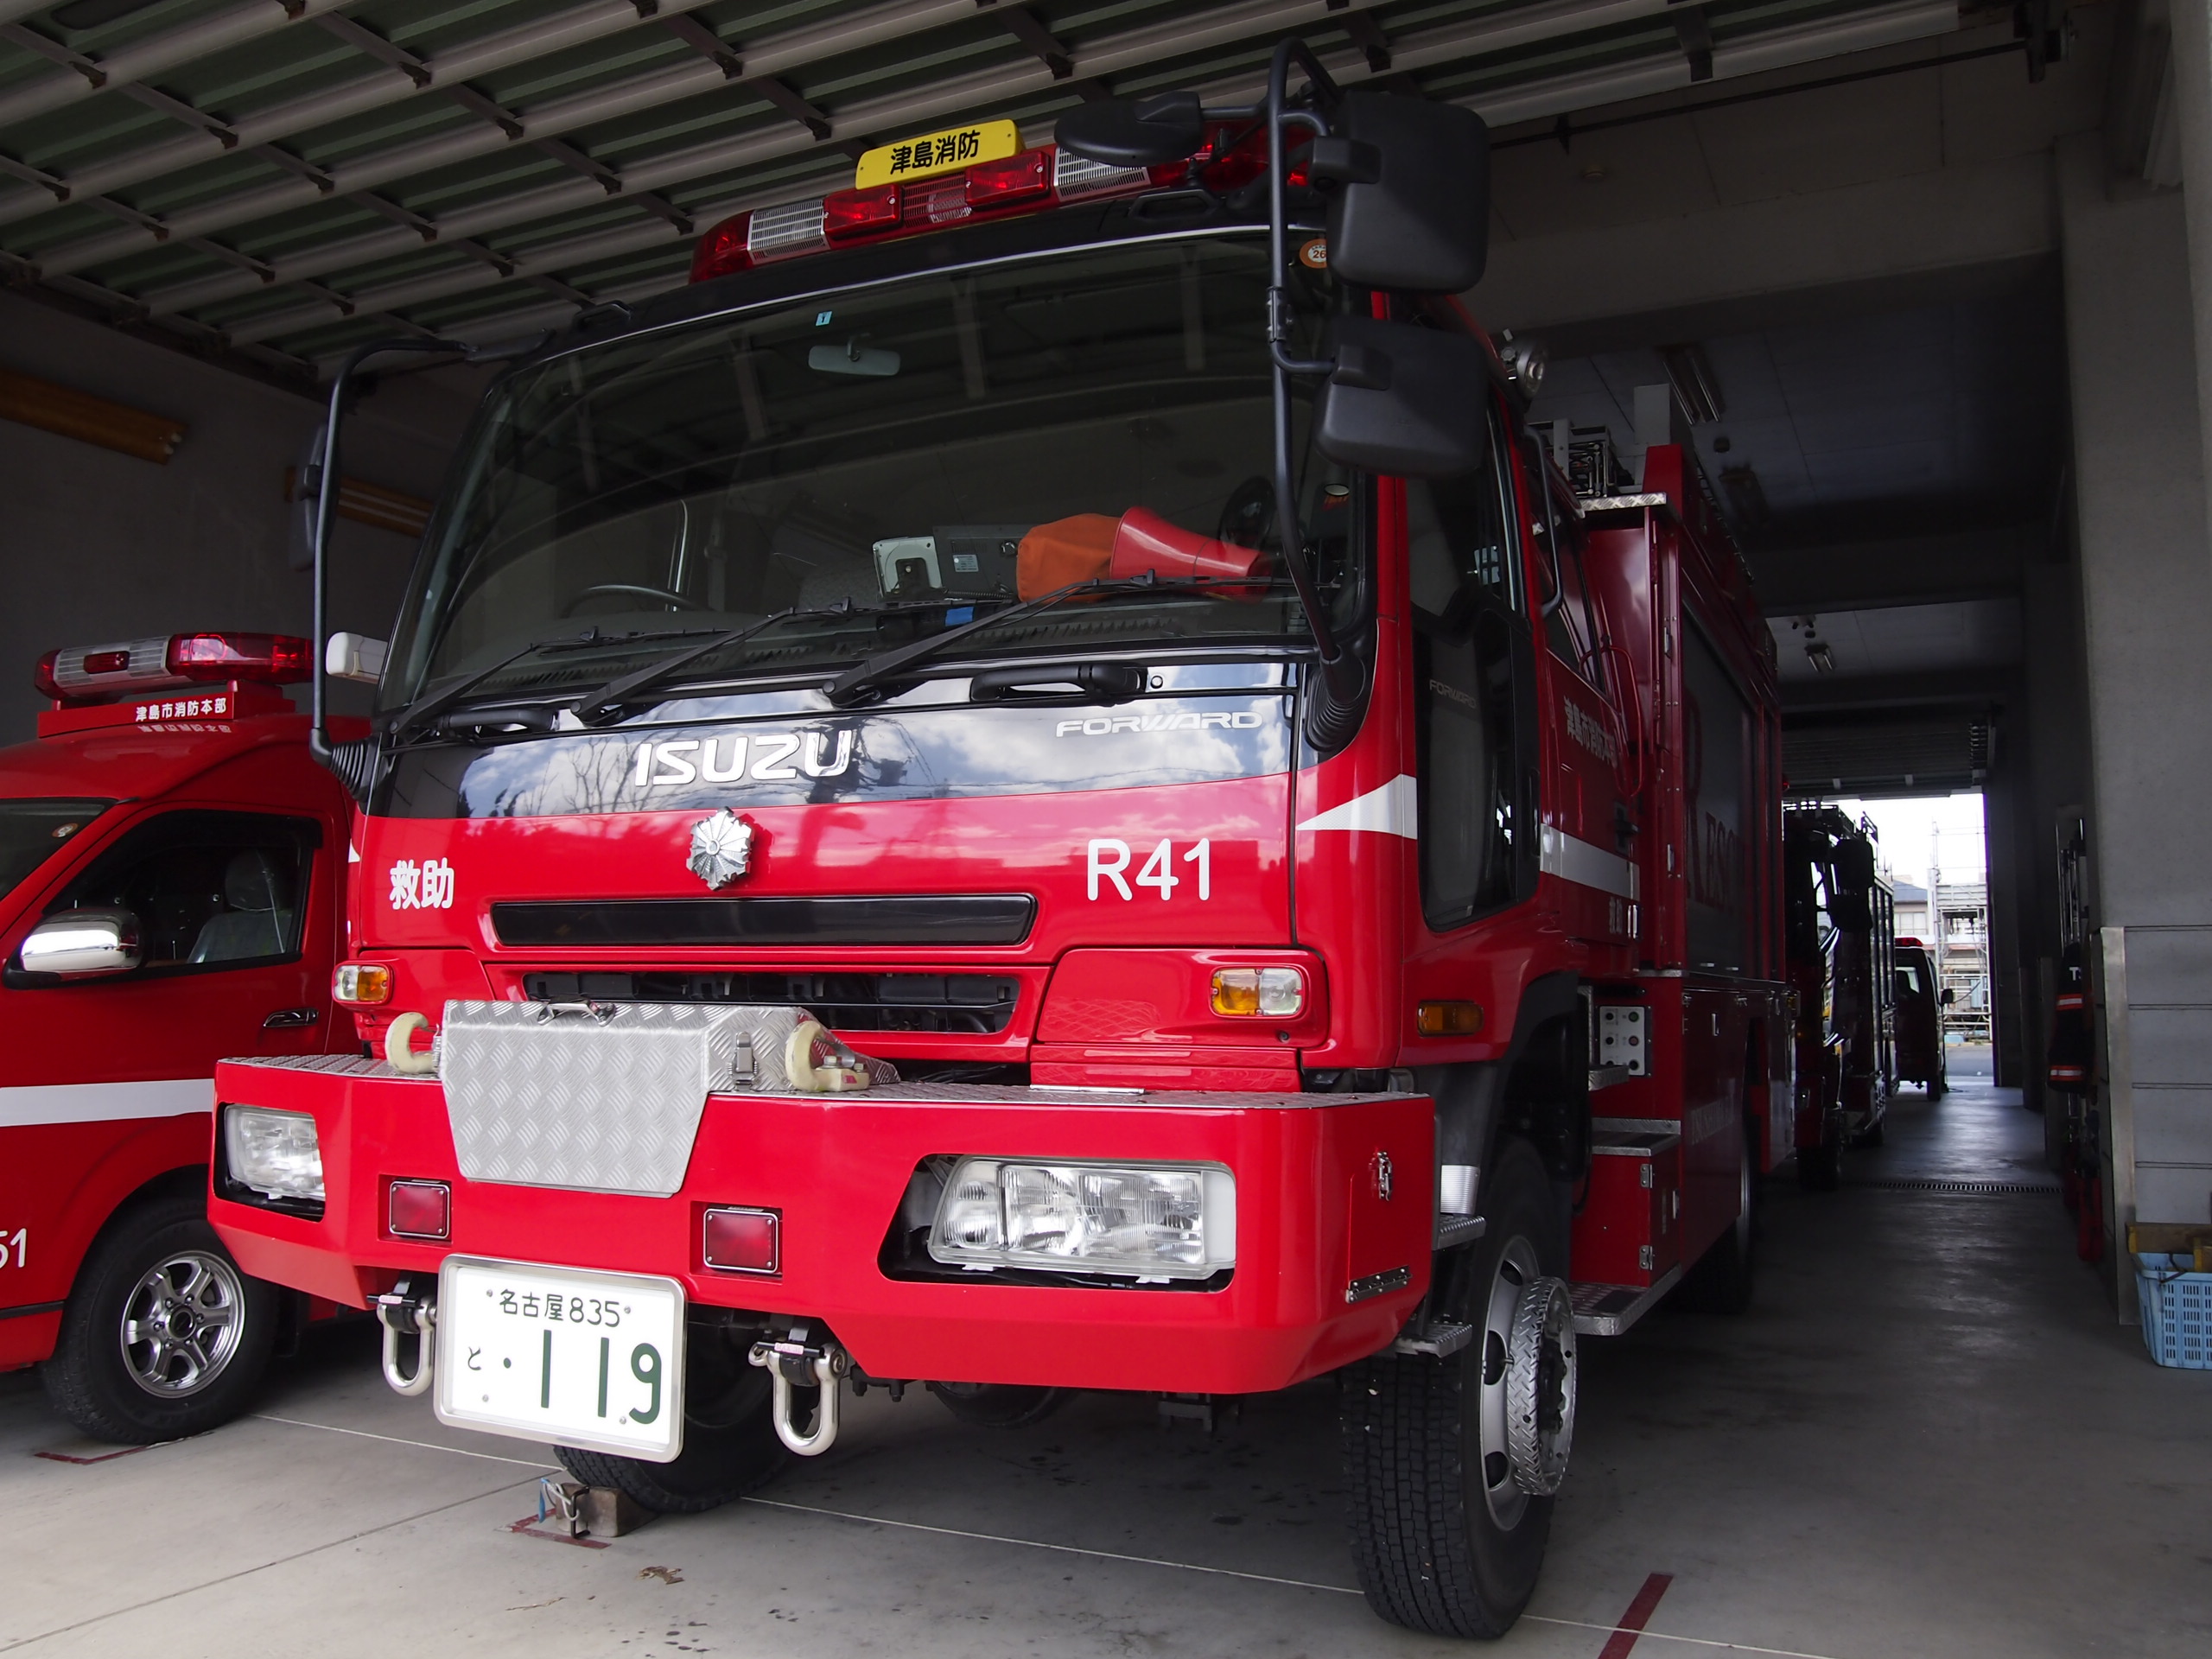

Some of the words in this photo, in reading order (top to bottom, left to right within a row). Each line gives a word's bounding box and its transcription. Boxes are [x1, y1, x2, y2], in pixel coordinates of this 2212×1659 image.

[890, 130, 980, 175] 津島消防
[135, 697, 227, 722] 津島市消防本部
[1056, 711, 1262, 737] FORWARD
[634, 730, 853, 787] ISUZU
[389, 856, 454, 910] 救助
[1087, 837, 1211, 901] R41
